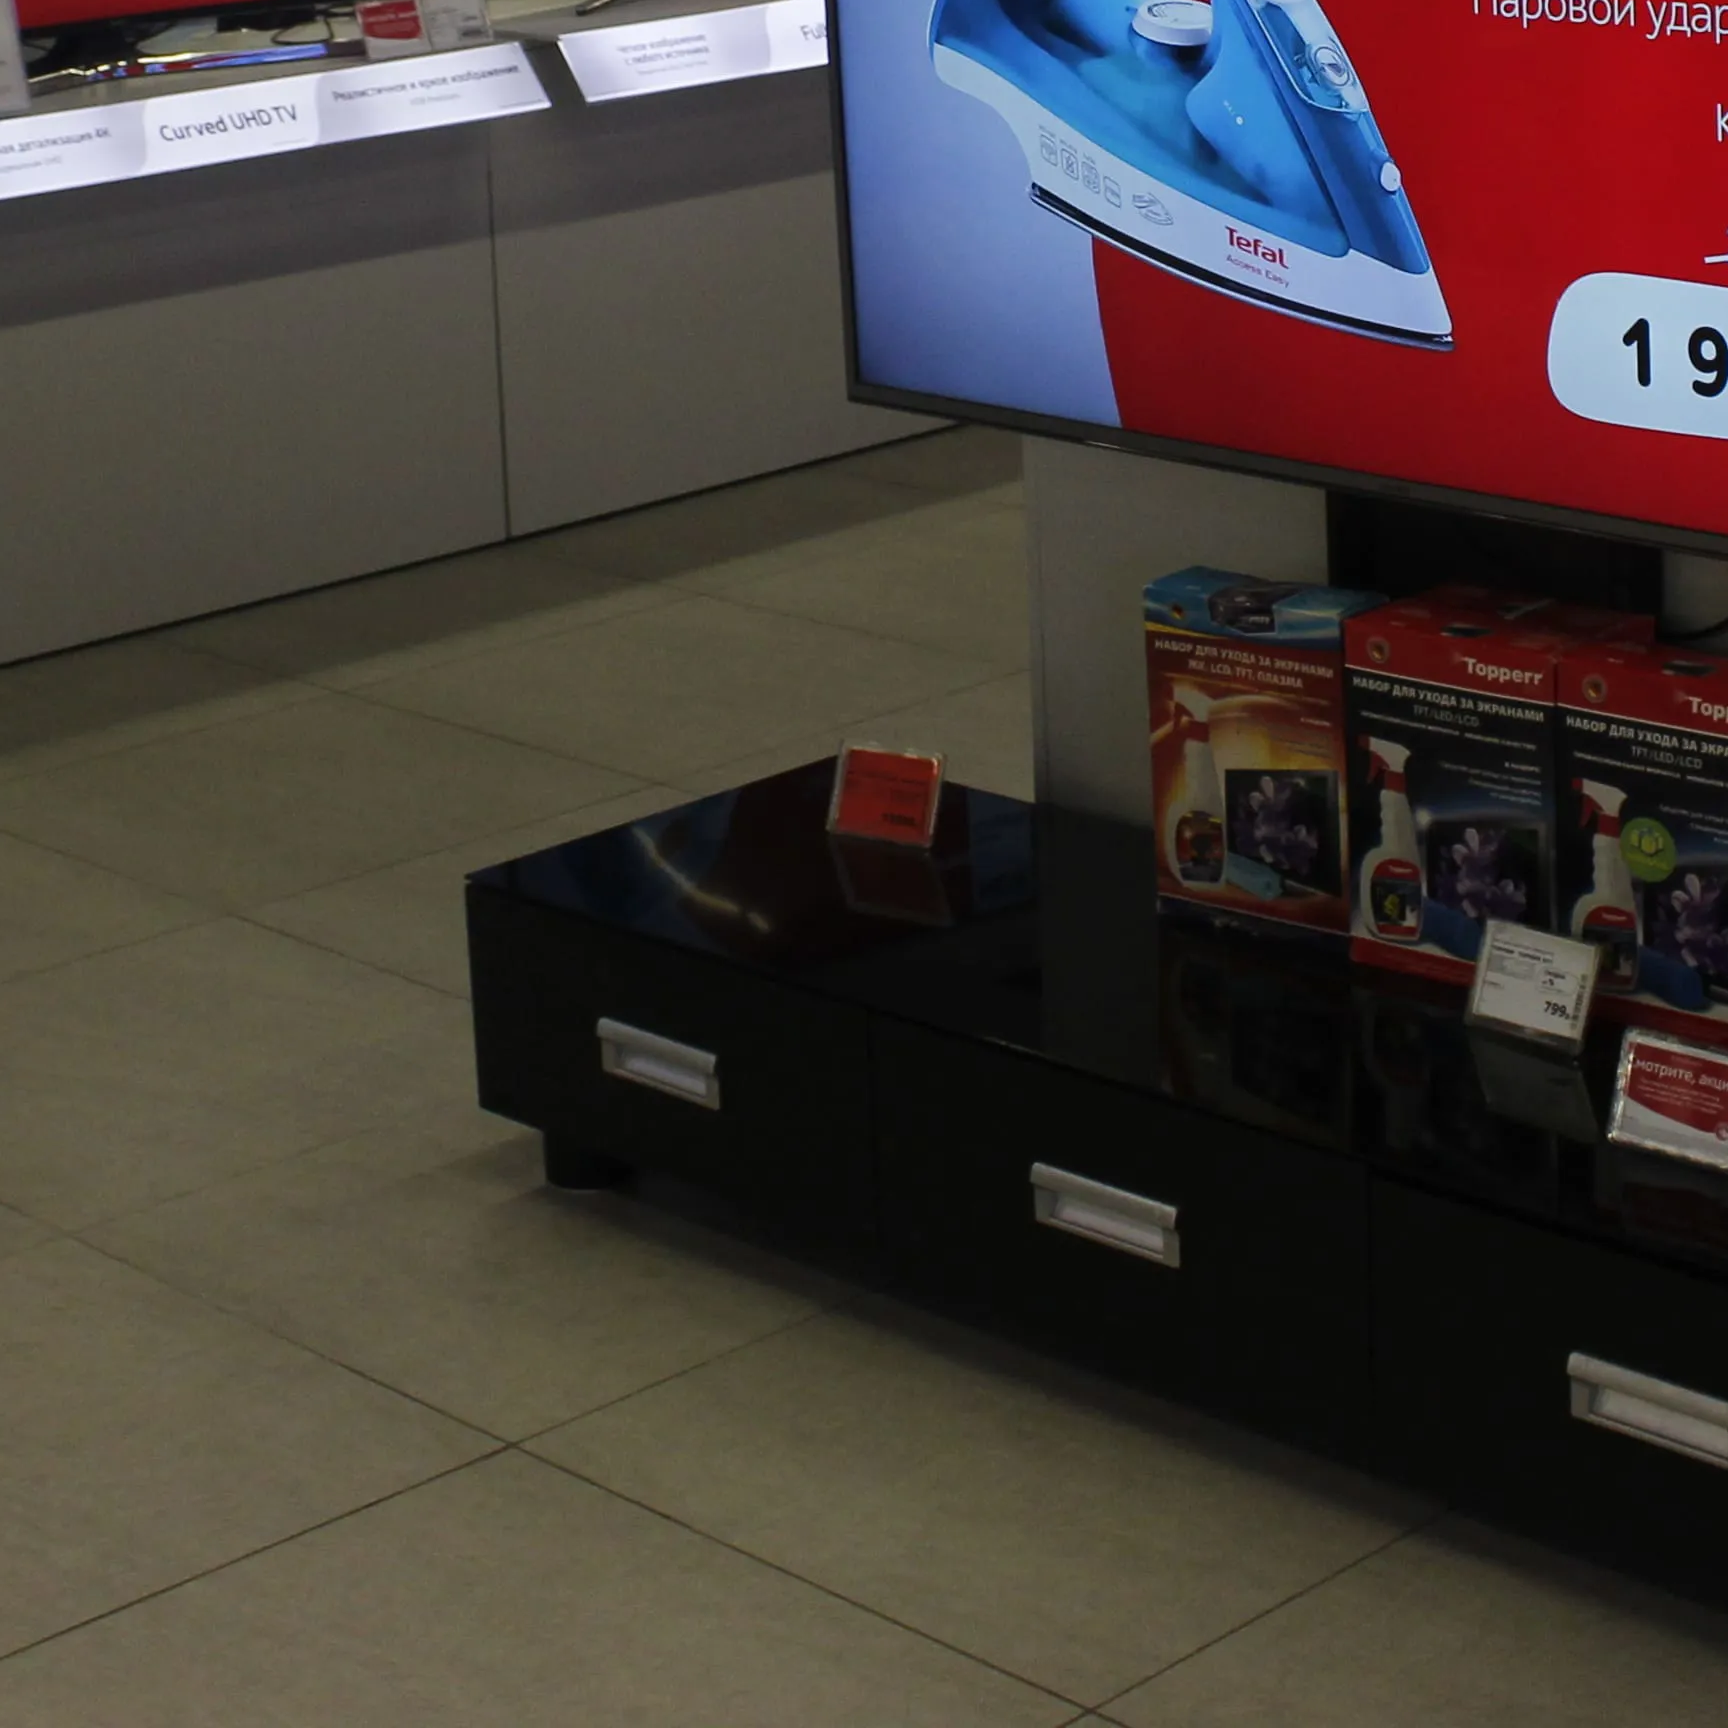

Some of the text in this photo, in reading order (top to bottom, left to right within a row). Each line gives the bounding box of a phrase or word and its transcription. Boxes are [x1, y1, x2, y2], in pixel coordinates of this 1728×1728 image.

[159, 103, 300, 143] Curved UHD TV
[1224, 225, 1290, 270] Tefal
[1226, 253, 1263, 276] Access
[1622, 318, 1653, 388] 1
[1154, 638, 1335, 680] НАБОР ДЛЯ УХОДА ЗА ЭКРАНАМИ
[1462, 656, 1545, 686] Topperr
[1352, 676, 1546, 724] НАБОР ДЛЯ УХОДА ЗА ЭКРАНАМИ
[1565, 714, 1608, 734] НАБОР
[1608, 723, 1636, 740] ДЛЯ
[1636, 727, 1680, 750] УХОДА
[1680, 737, 1699, 753] ЗА
[1630, 745, 1704, 771] TFT/LED/LCD
